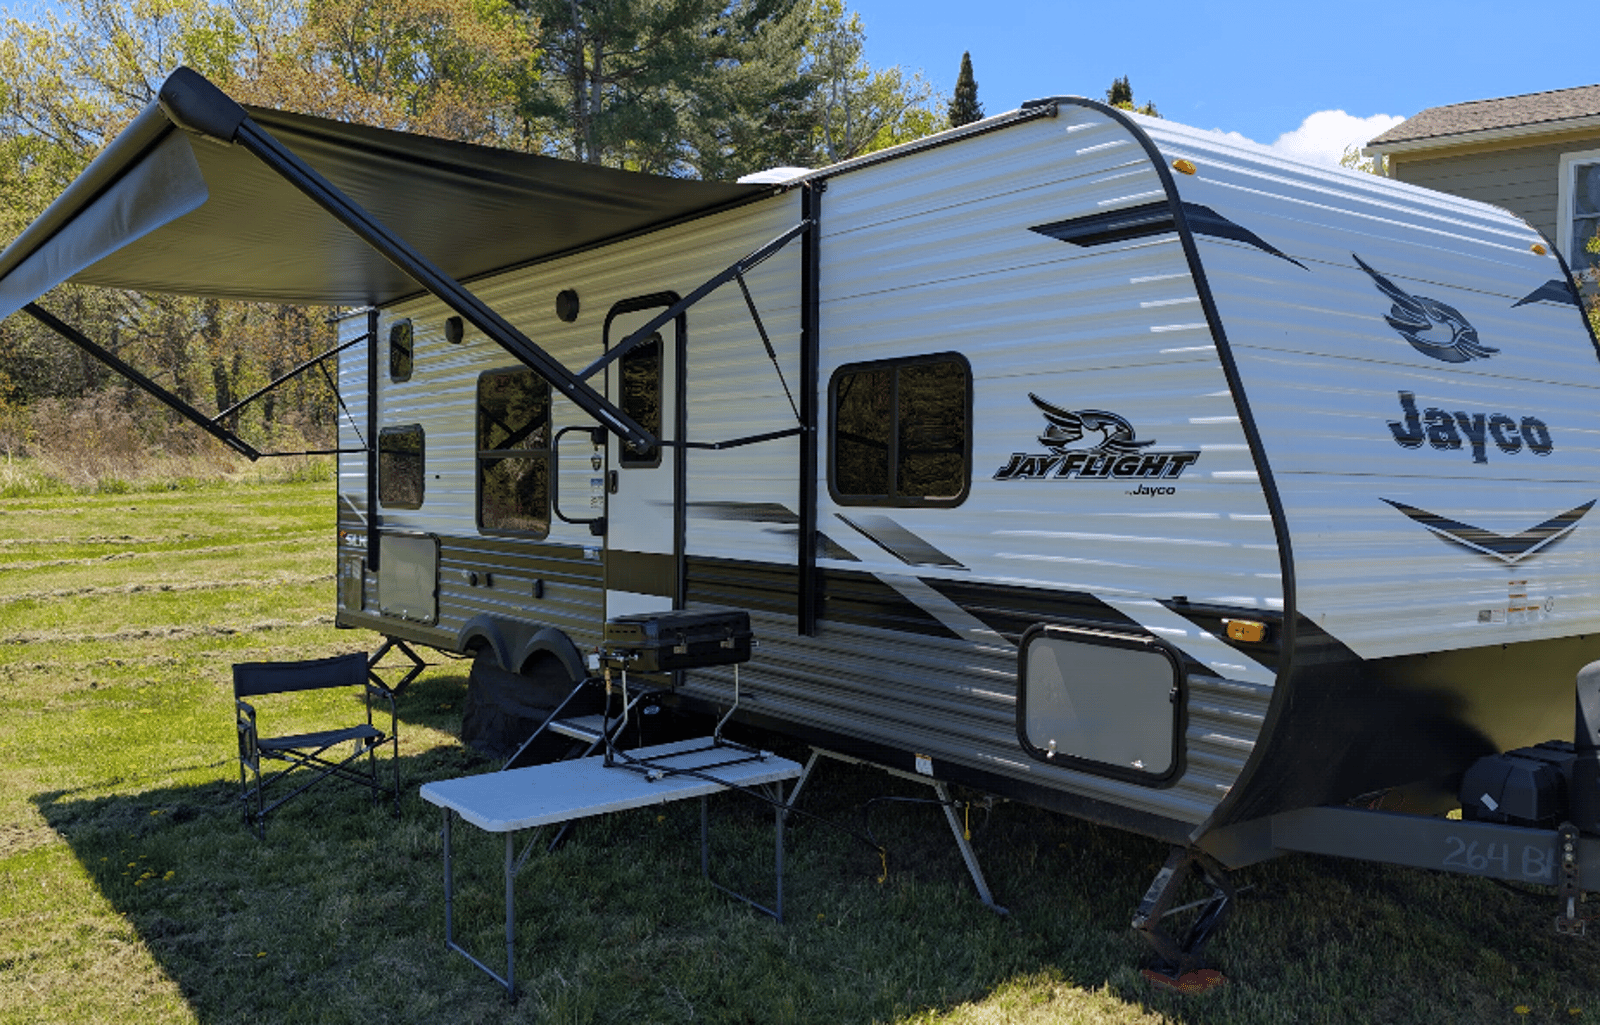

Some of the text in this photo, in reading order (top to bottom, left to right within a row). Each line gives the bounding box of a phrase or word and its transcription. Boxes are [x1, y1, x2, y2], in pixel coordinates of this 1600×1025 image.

[1386, 390, 1554, 464] Jayco
[1133, 483, 1176, 498] Jayco
[1442, 836, 1509, 872] 264
